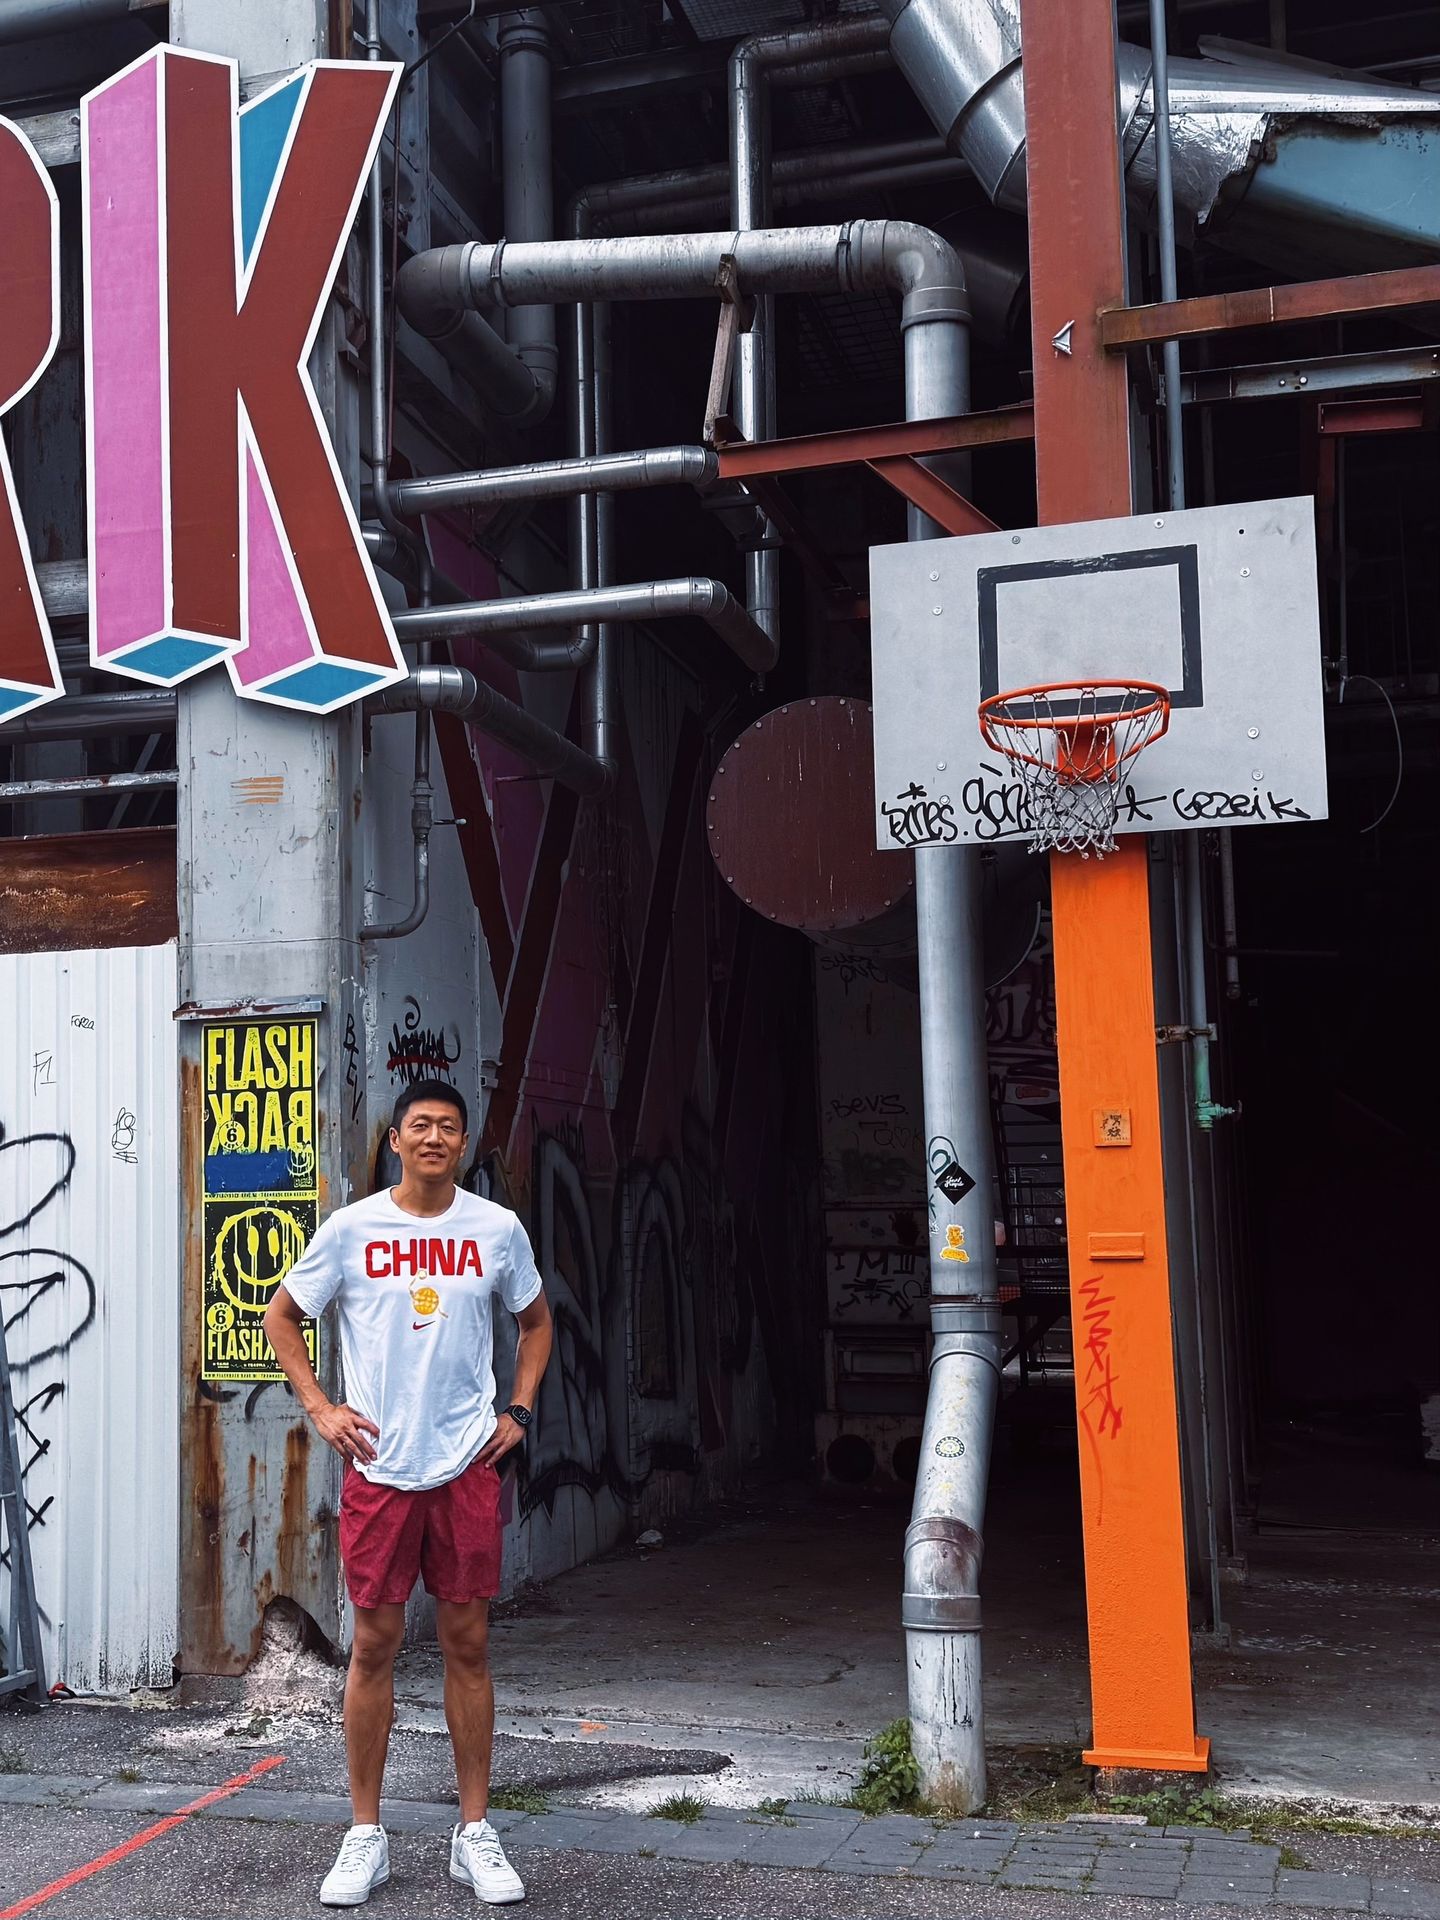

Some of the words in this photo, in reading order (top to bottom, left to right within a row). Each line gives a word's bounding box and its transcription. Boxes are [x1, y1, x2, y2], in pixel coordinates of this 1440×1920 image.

[207, 1025, 312, 1091] FLASH
[226, 1127, 238, 1143] 6
[365, 1238, 483, 1278] CHINA
[215, 1309, 227, 1325] 6
[236, 1319, 250, 1327] the
